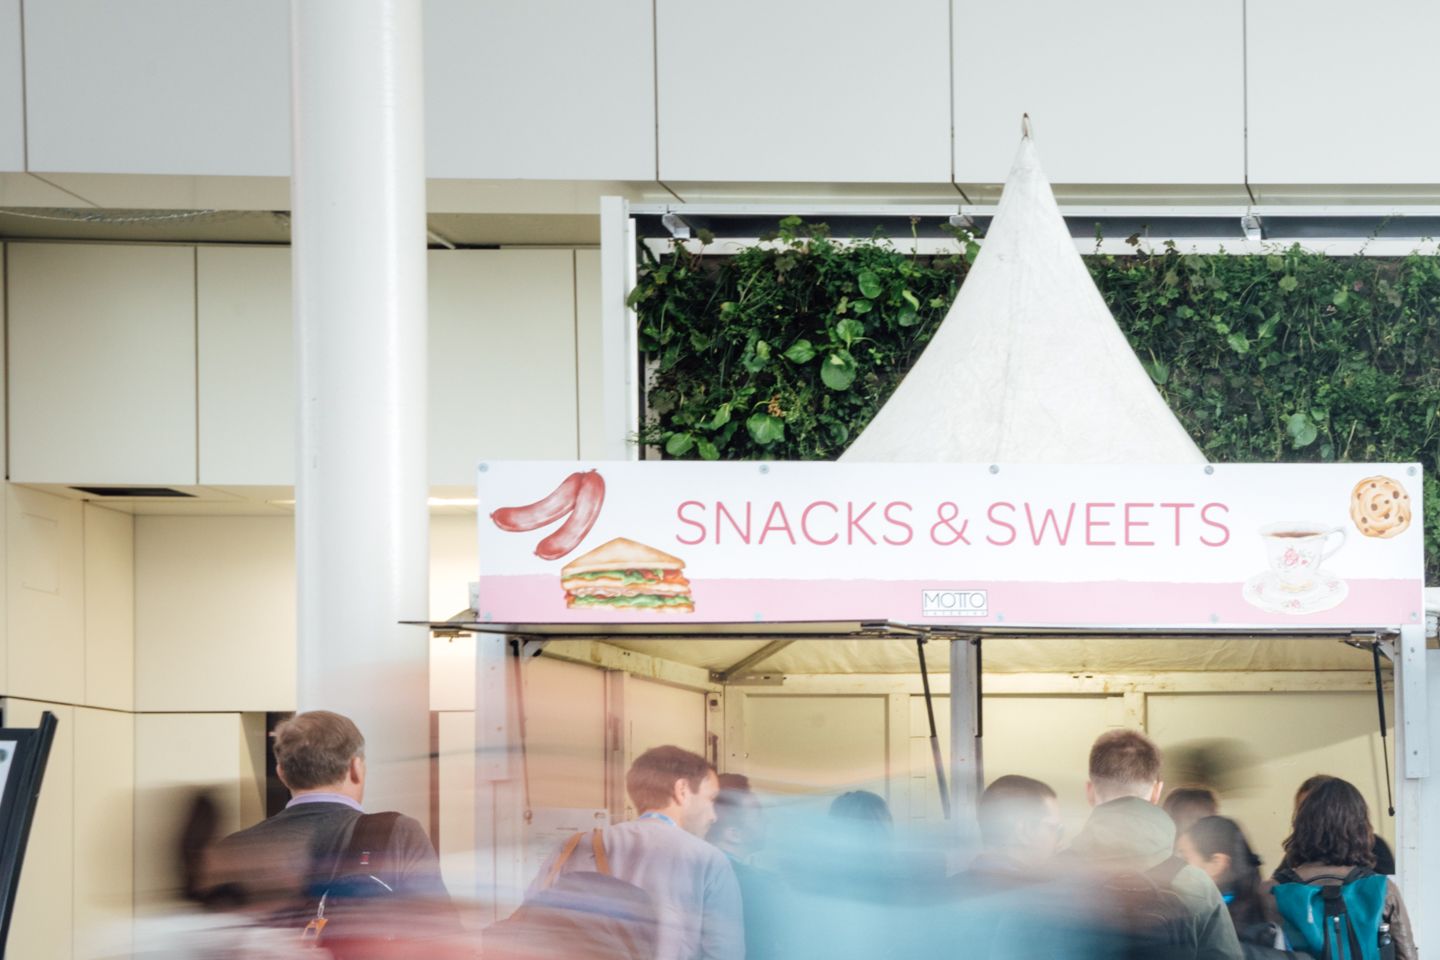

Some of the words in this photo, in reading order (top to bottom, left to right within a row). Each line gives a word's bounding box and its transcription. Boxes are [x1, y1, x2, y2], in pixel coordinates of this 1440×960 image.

[675, 500, 914, 546] SNACKS
[929, 501, 972, 546] &
[985, 502, 1231, 547] SWEETS
[924, 592, 986, 609] MOTTO
